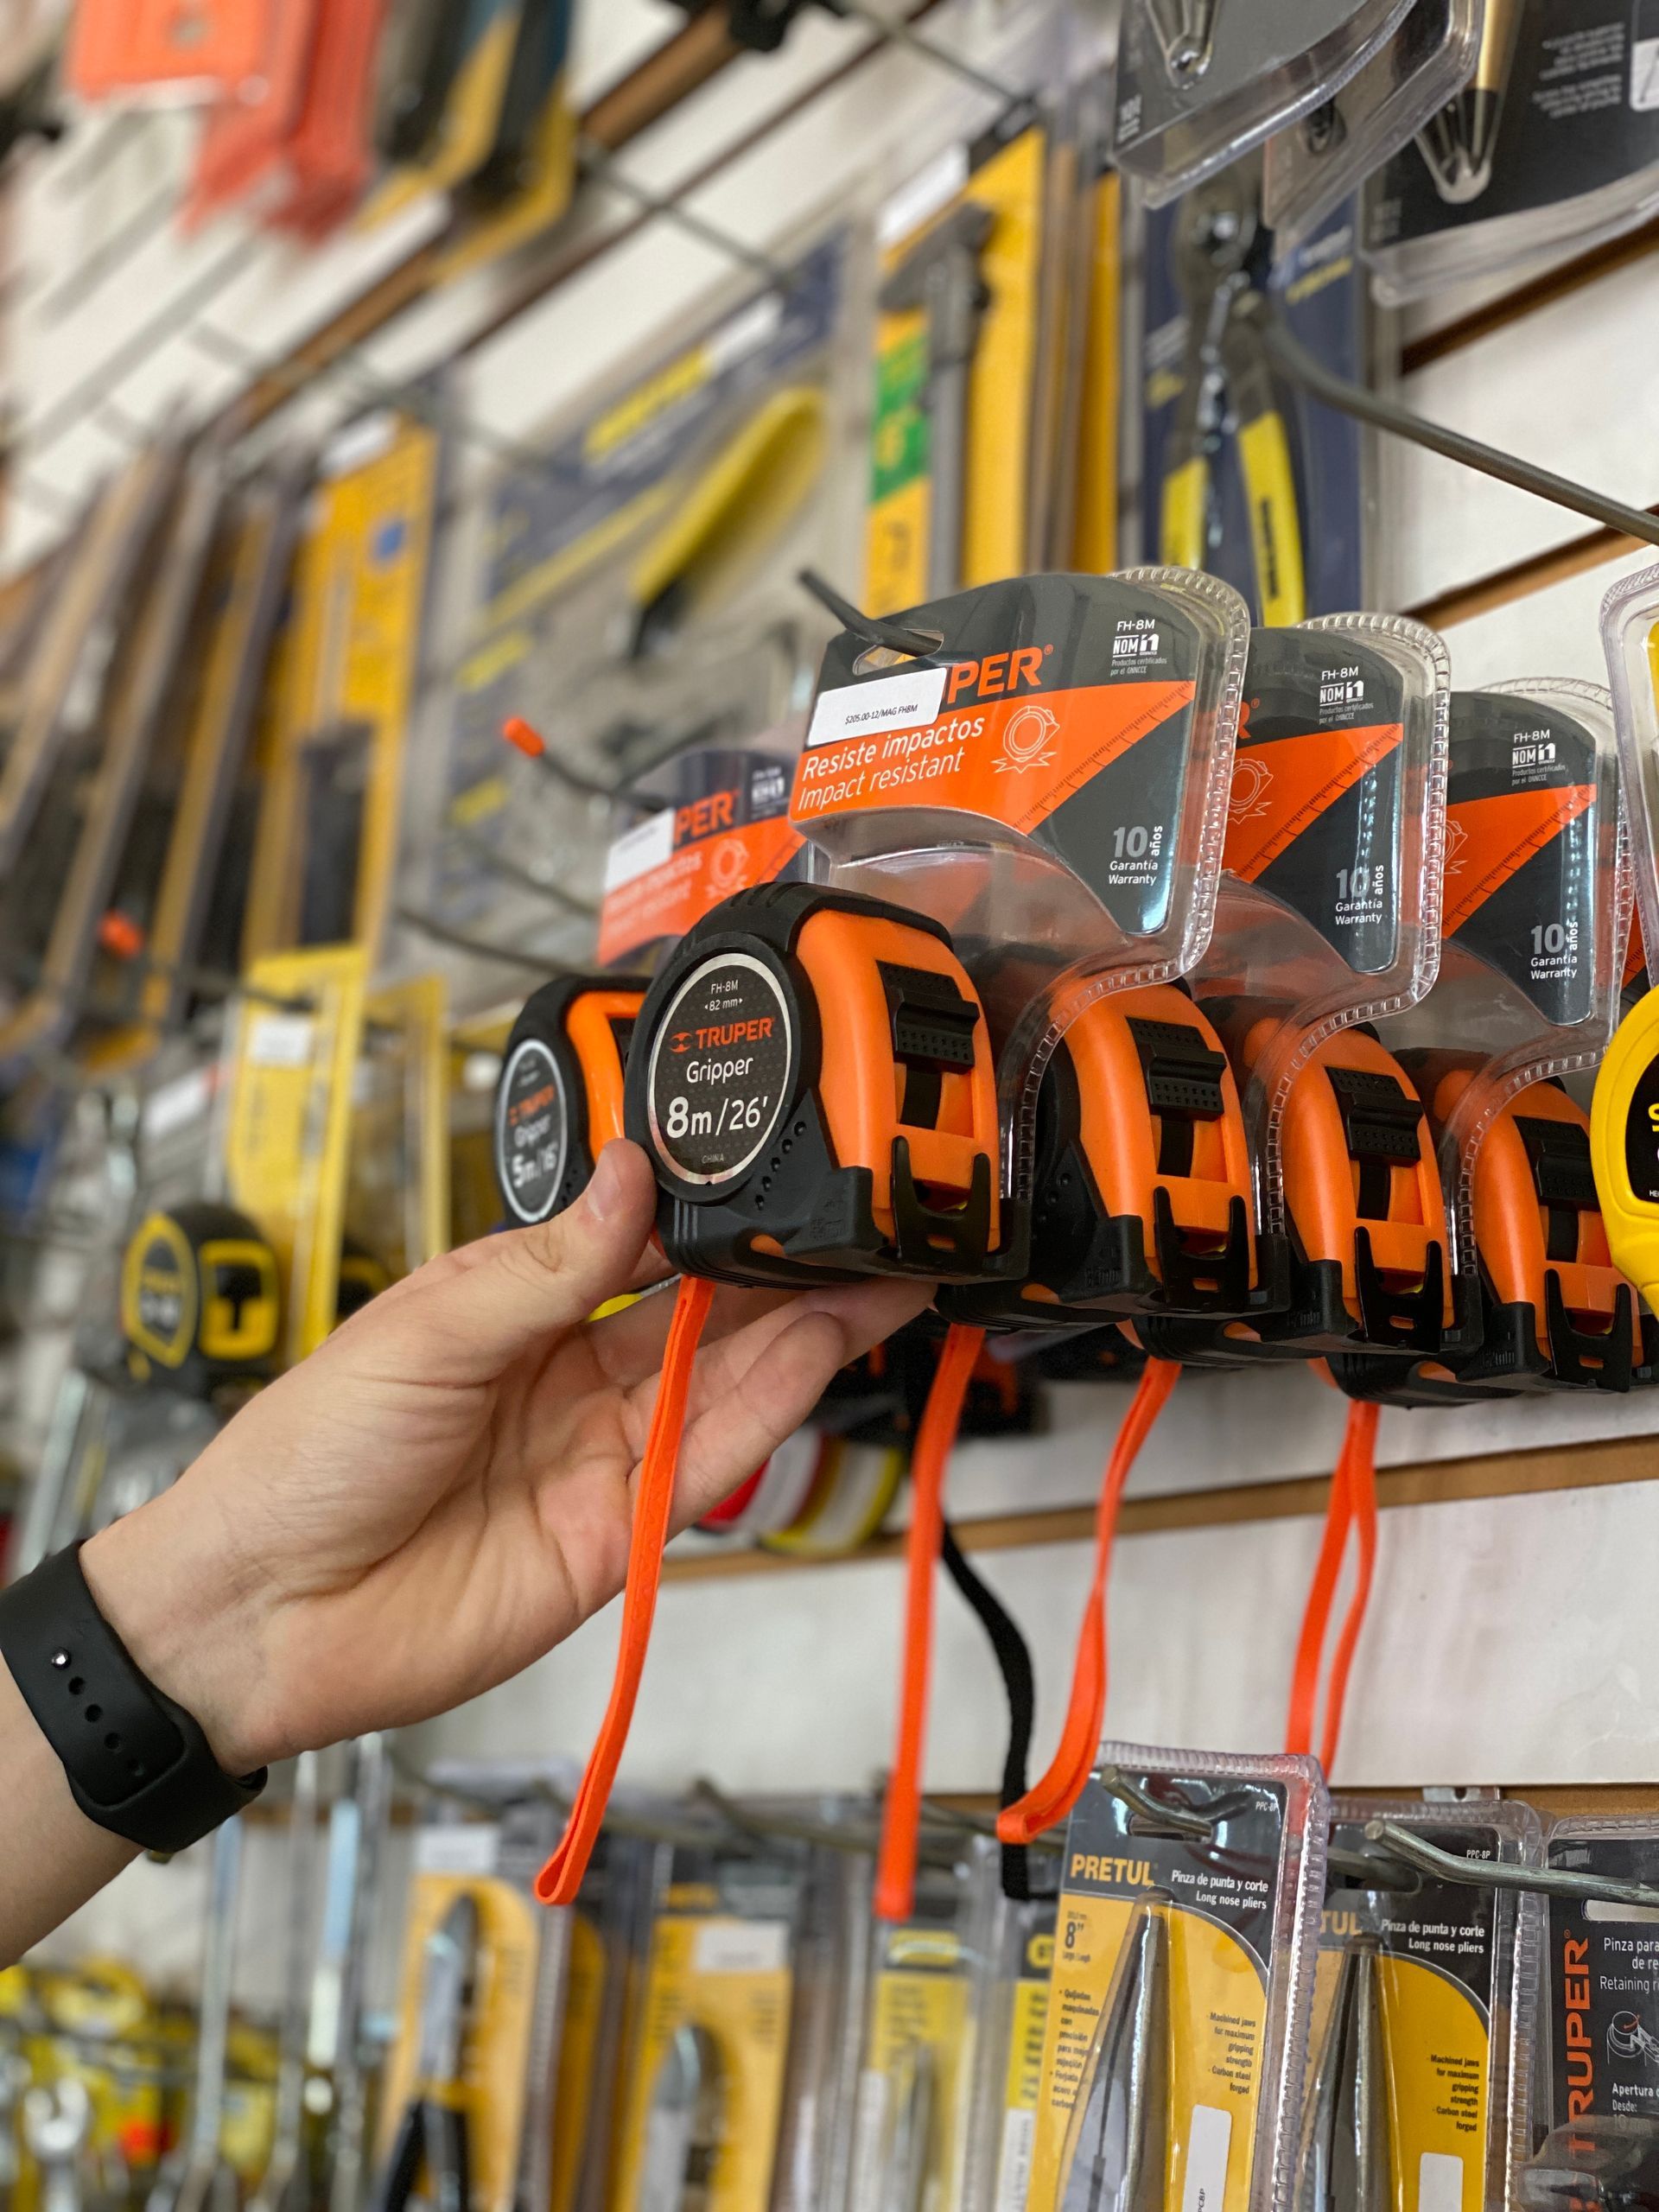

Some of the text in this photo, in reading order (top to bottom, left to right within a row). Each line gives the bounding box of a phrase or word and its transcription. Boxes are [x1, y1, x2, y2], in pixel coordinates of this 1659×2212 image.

[1116, 619, 1155, 632] FH-8M
[1112, 638, 1139, 655] NOM
[944, 646, 1043, 704] PER
[1321, 665, 1359, 681] FH-8M
[1319, 686, 1344, 703] NOM
[1514, 728, 1550, 743] FH-8M
[802, 716, 985, 782] Resiste impactos
[1512, 748, 1536, 766] NOM
[798, 772, 866, 811] Impact
[869, 747, 965, 792] resistant
[674, 790, 734, 845] PER
[1113, 825, 1163, 857] 10 años
[1109, 859, 1159, 871] Garantía
[1109, 874, 1157, 886] Warranty
[1336, 864, 1384, 899] 10 años
[1335, 899, 1382, 912] Garantía
[1335, 912, 1382, 925] Warranty
[1530, 921, 1579, 955] 10 años
[1530, 953, 1578, 967] Garantía
[1530, 967, 1578, 980] Warranty
[710, 979, 739, 995] FH-8M
[709, 997, 738, 1011] 82 mm
[696, 1017, 772, 1051] TRUPER
[686, 1057, 753, 1085] Gripper
[702, 1153, 725, 1164] CHINA
[1466, 1849, 1491, 1859] PPC-8P
[1070, 1853, 1154, 1886] PRETUL
[1172, 1869, 1268, 1893] Pinza de punta y corte
[1196, 1890, 1268, 1910] Long nose pliers
[1320, 1910, 1363, 1936] TUL
[1382, 1918, 1485, 1937] Pinza de punta y corte
[1408, 1937, 1484, 1954] Long nose pliers
[1604, 1937, 1659, 1955] Pinza para
[1631, 1955, 1645, 1969] de
[1599, 1975, 1650, 1994] Retaining
[1210, 2012, 1256, 2027] Machined jaws
[1214, 2026, 1255, 2040] for maximum
[1228, 2043, 1254, 2056] gripping
[1226, 2056, 1252, 2069] strength
[1430, 2054, 1479, 2068] Machined jaws
[1211, 2064, 1251, 2081] Carbon steel
[1436, 2067, 1479, 2080] for maximum
[1230, 2082, 1250, 2094] forged
[1452, 2082, 1479, 2094] gripping
[1611, 2082, 1654, 2097] Apertura
[1451, 2095, 1478, 2107] strength
[1612, 2099, 1637, 2113] Desde:
[1436, 2106, 1478, 2119] Carbon steel
[1456, 2120, 1478, 2133] forged
